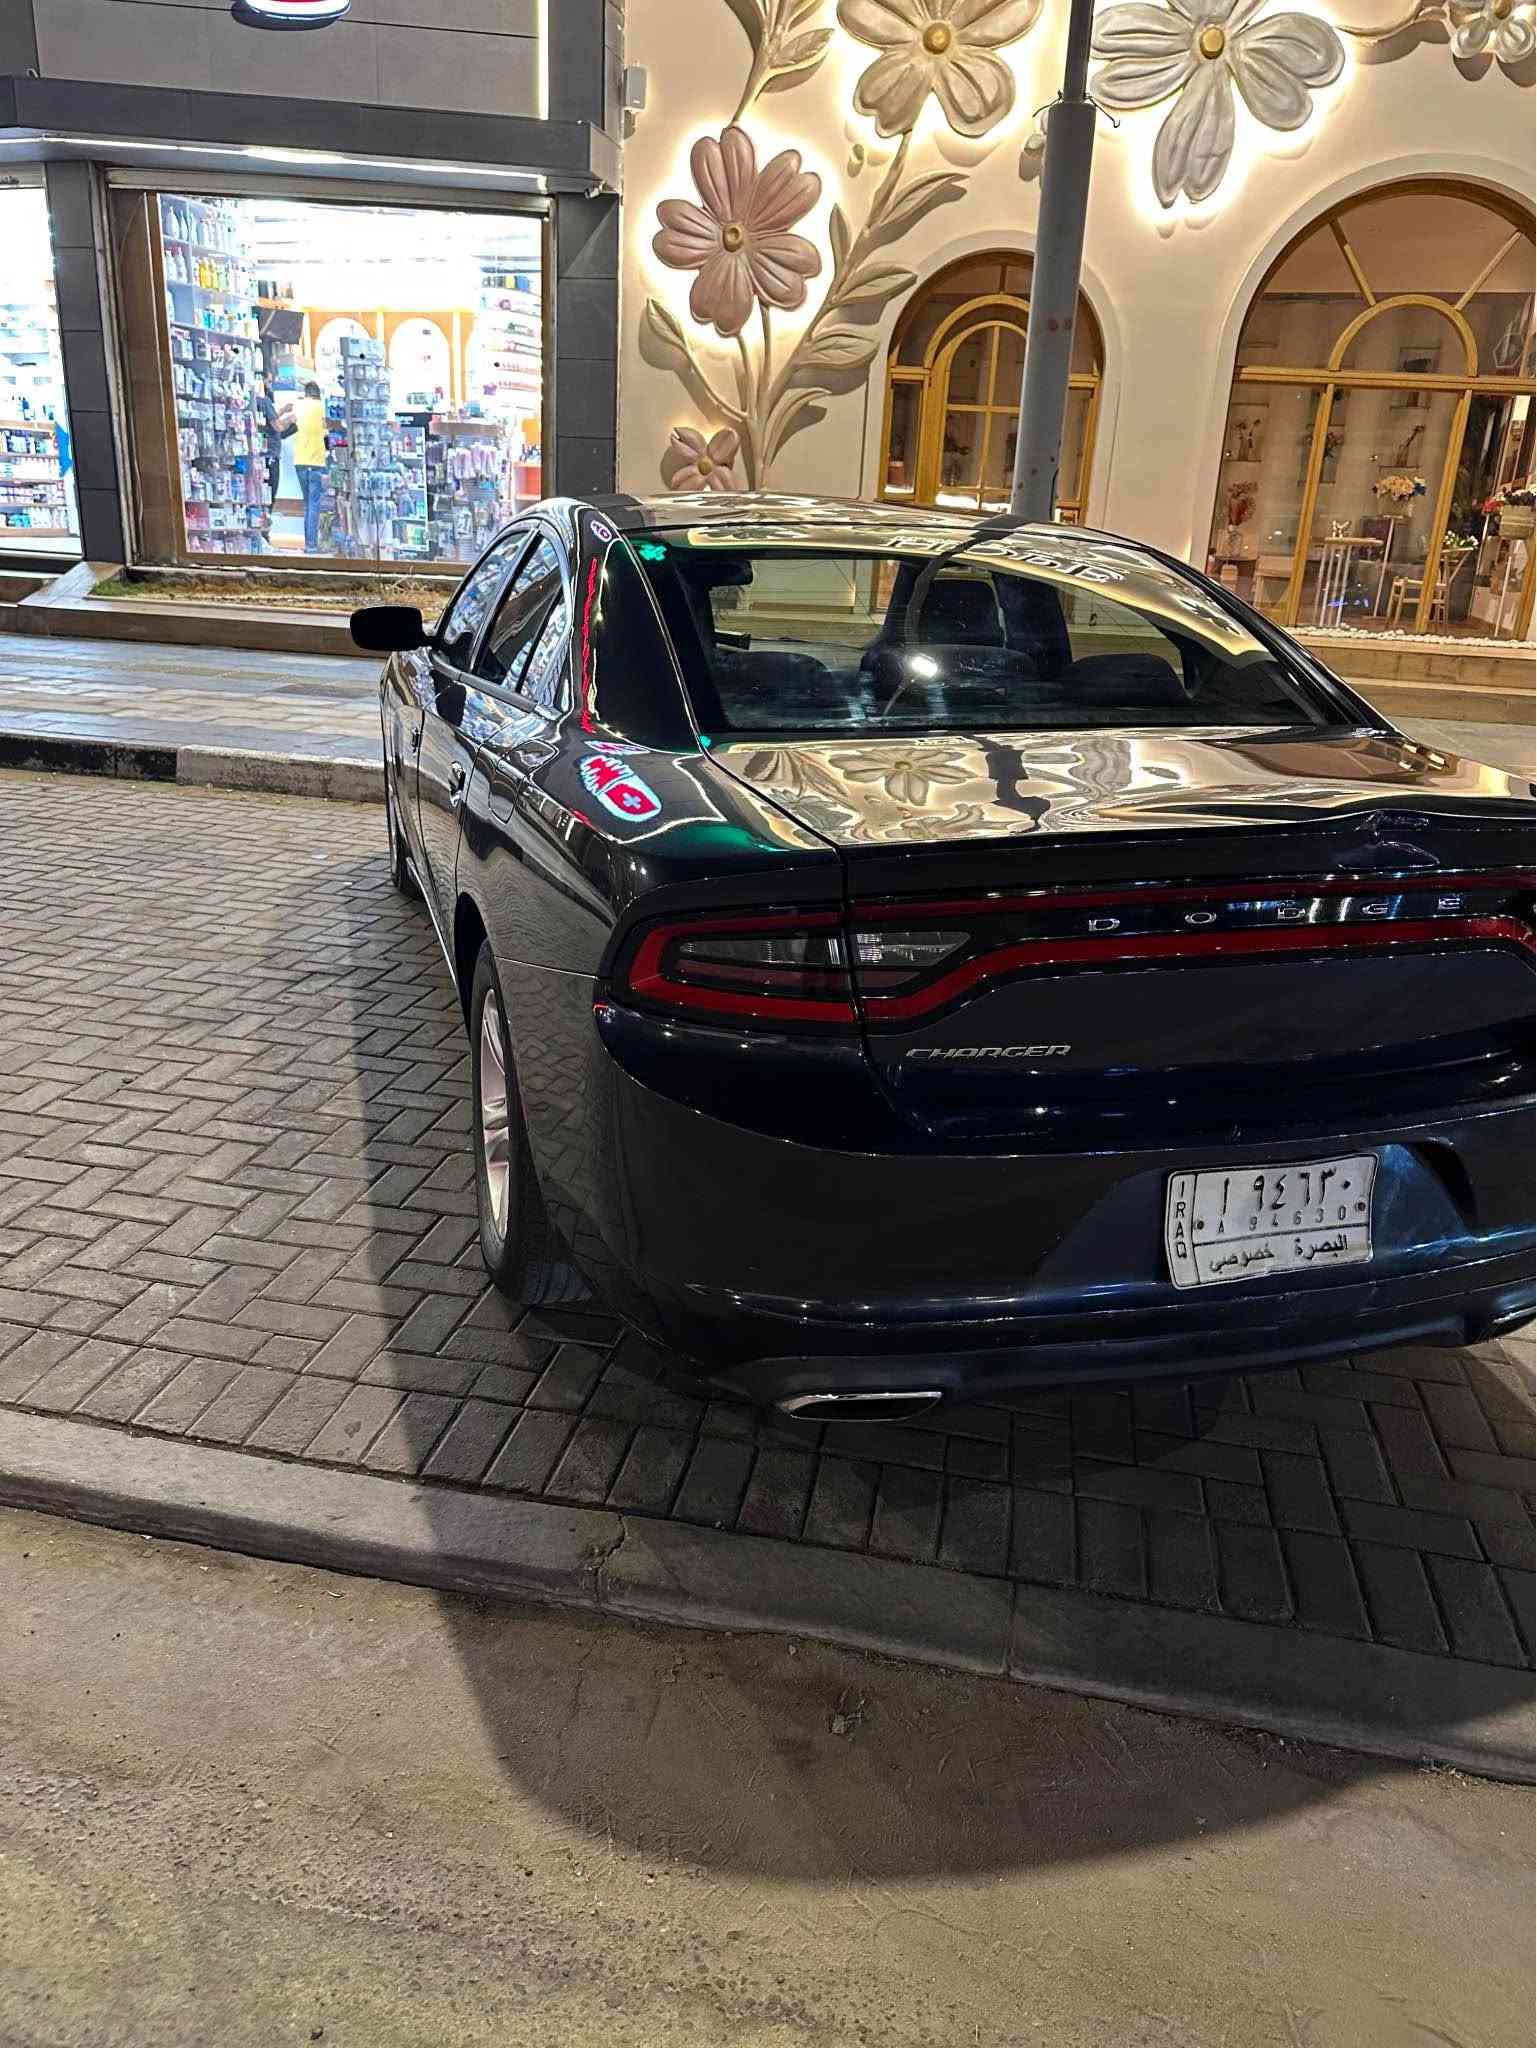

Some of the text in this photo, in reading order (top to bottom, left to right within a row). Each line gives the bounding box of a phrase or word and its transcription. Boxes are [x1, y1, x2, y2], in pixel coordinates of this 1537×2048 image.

[1088, 896, 1463, 932] DODGE
[906, 1045, 1072, 1058] CHARGER
[1175, 1180, 1188, 1259] IRAQ
[1209, 1233, 1348, 1274] البصرة خصوصي
